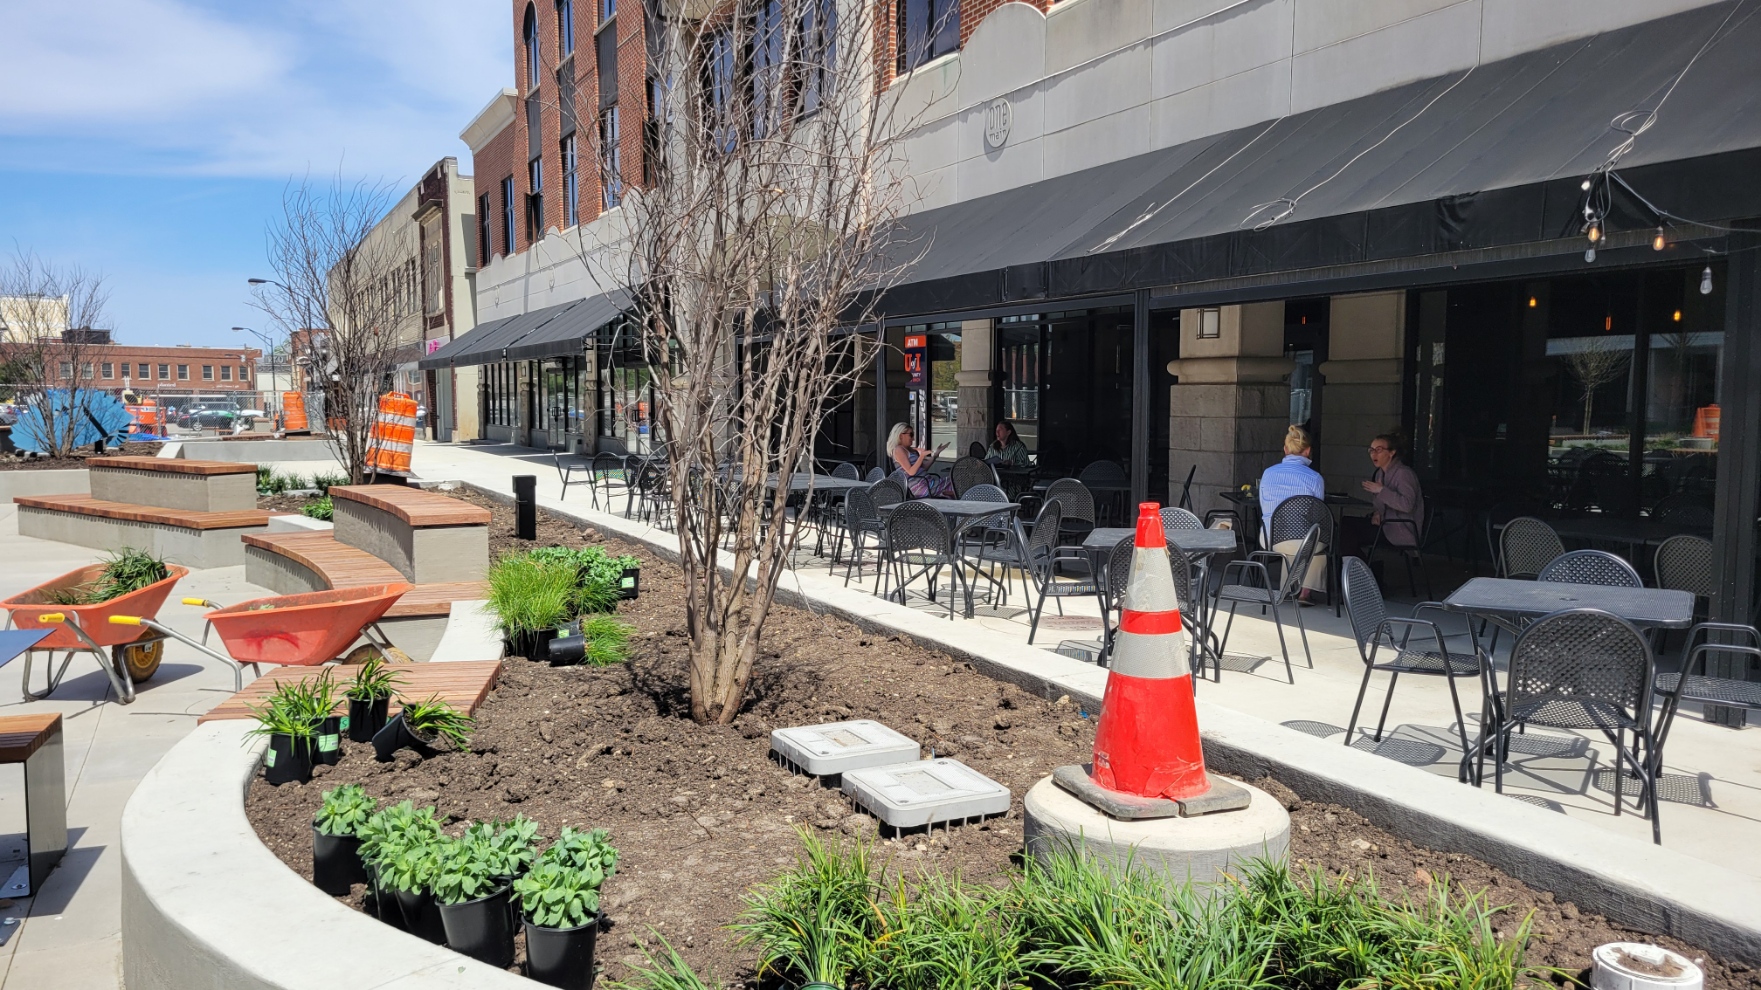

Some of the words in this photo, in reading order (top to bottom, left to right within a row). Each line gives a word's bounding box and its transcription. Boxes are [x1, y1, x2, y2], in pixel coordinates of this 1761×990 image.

[989, 102, 1007, 129] one
[989, 128, 1006, 141] main
[907, 338, 919, 347] ATM
